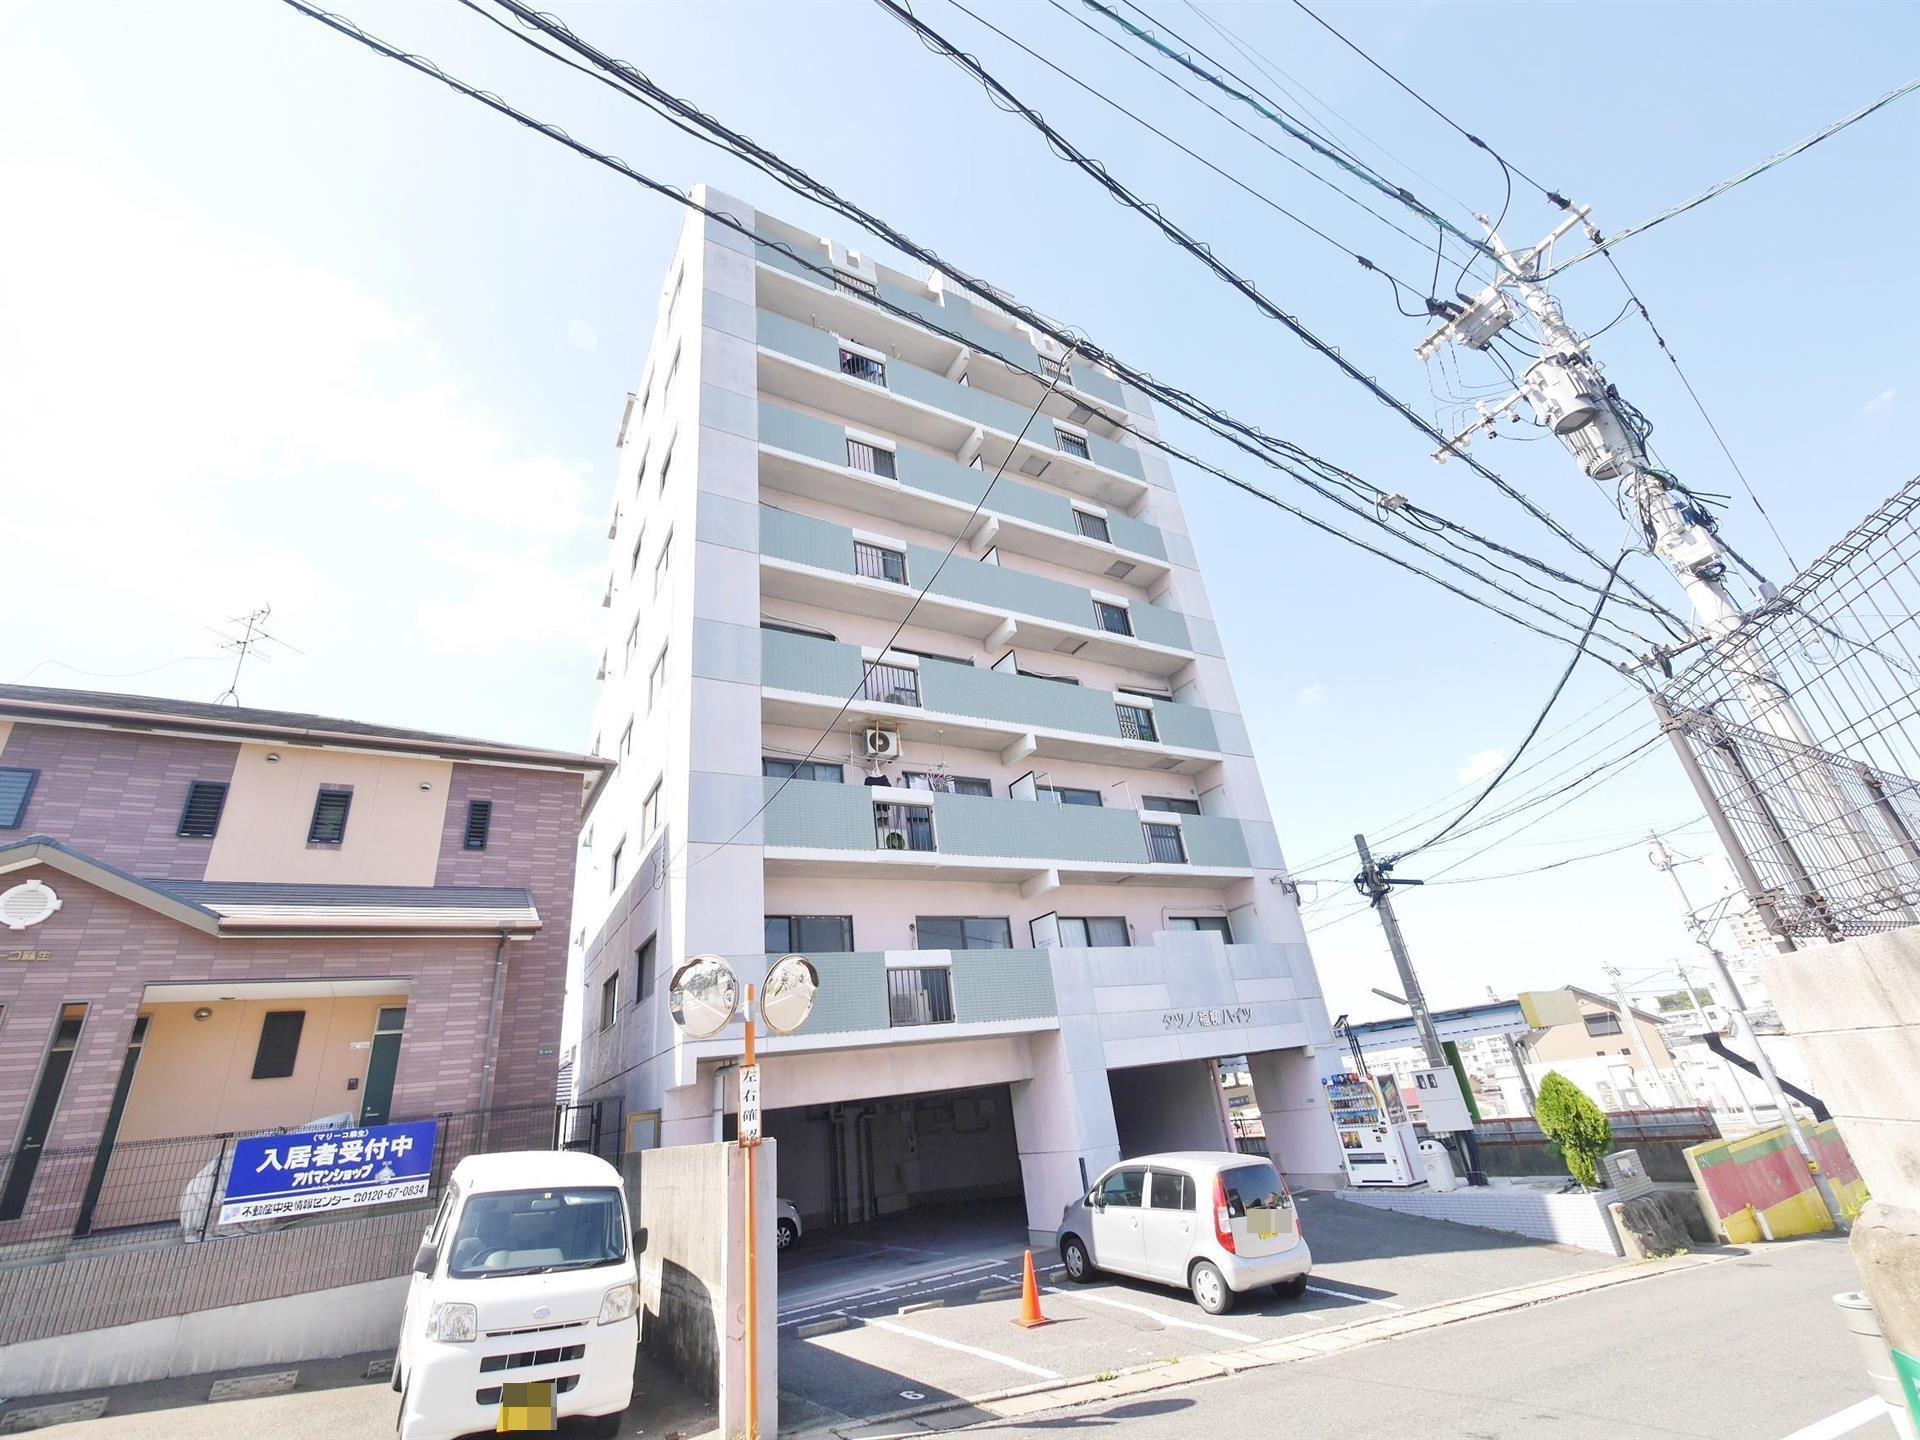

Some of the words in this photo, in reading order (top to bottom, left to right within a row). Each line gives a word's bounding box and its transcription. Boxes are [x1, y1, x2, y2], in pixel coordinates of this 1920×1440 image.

[255, 1135, 413, 1173] 入居者受付中
[291, 1163, 374, 1187] アパマンショップ
[242, 1195, 351, 1218] 不動産中央情報センター
[361, 1184, 425, 1202] 0120-67-0834
[899, 1390, 926, 1400] 6
